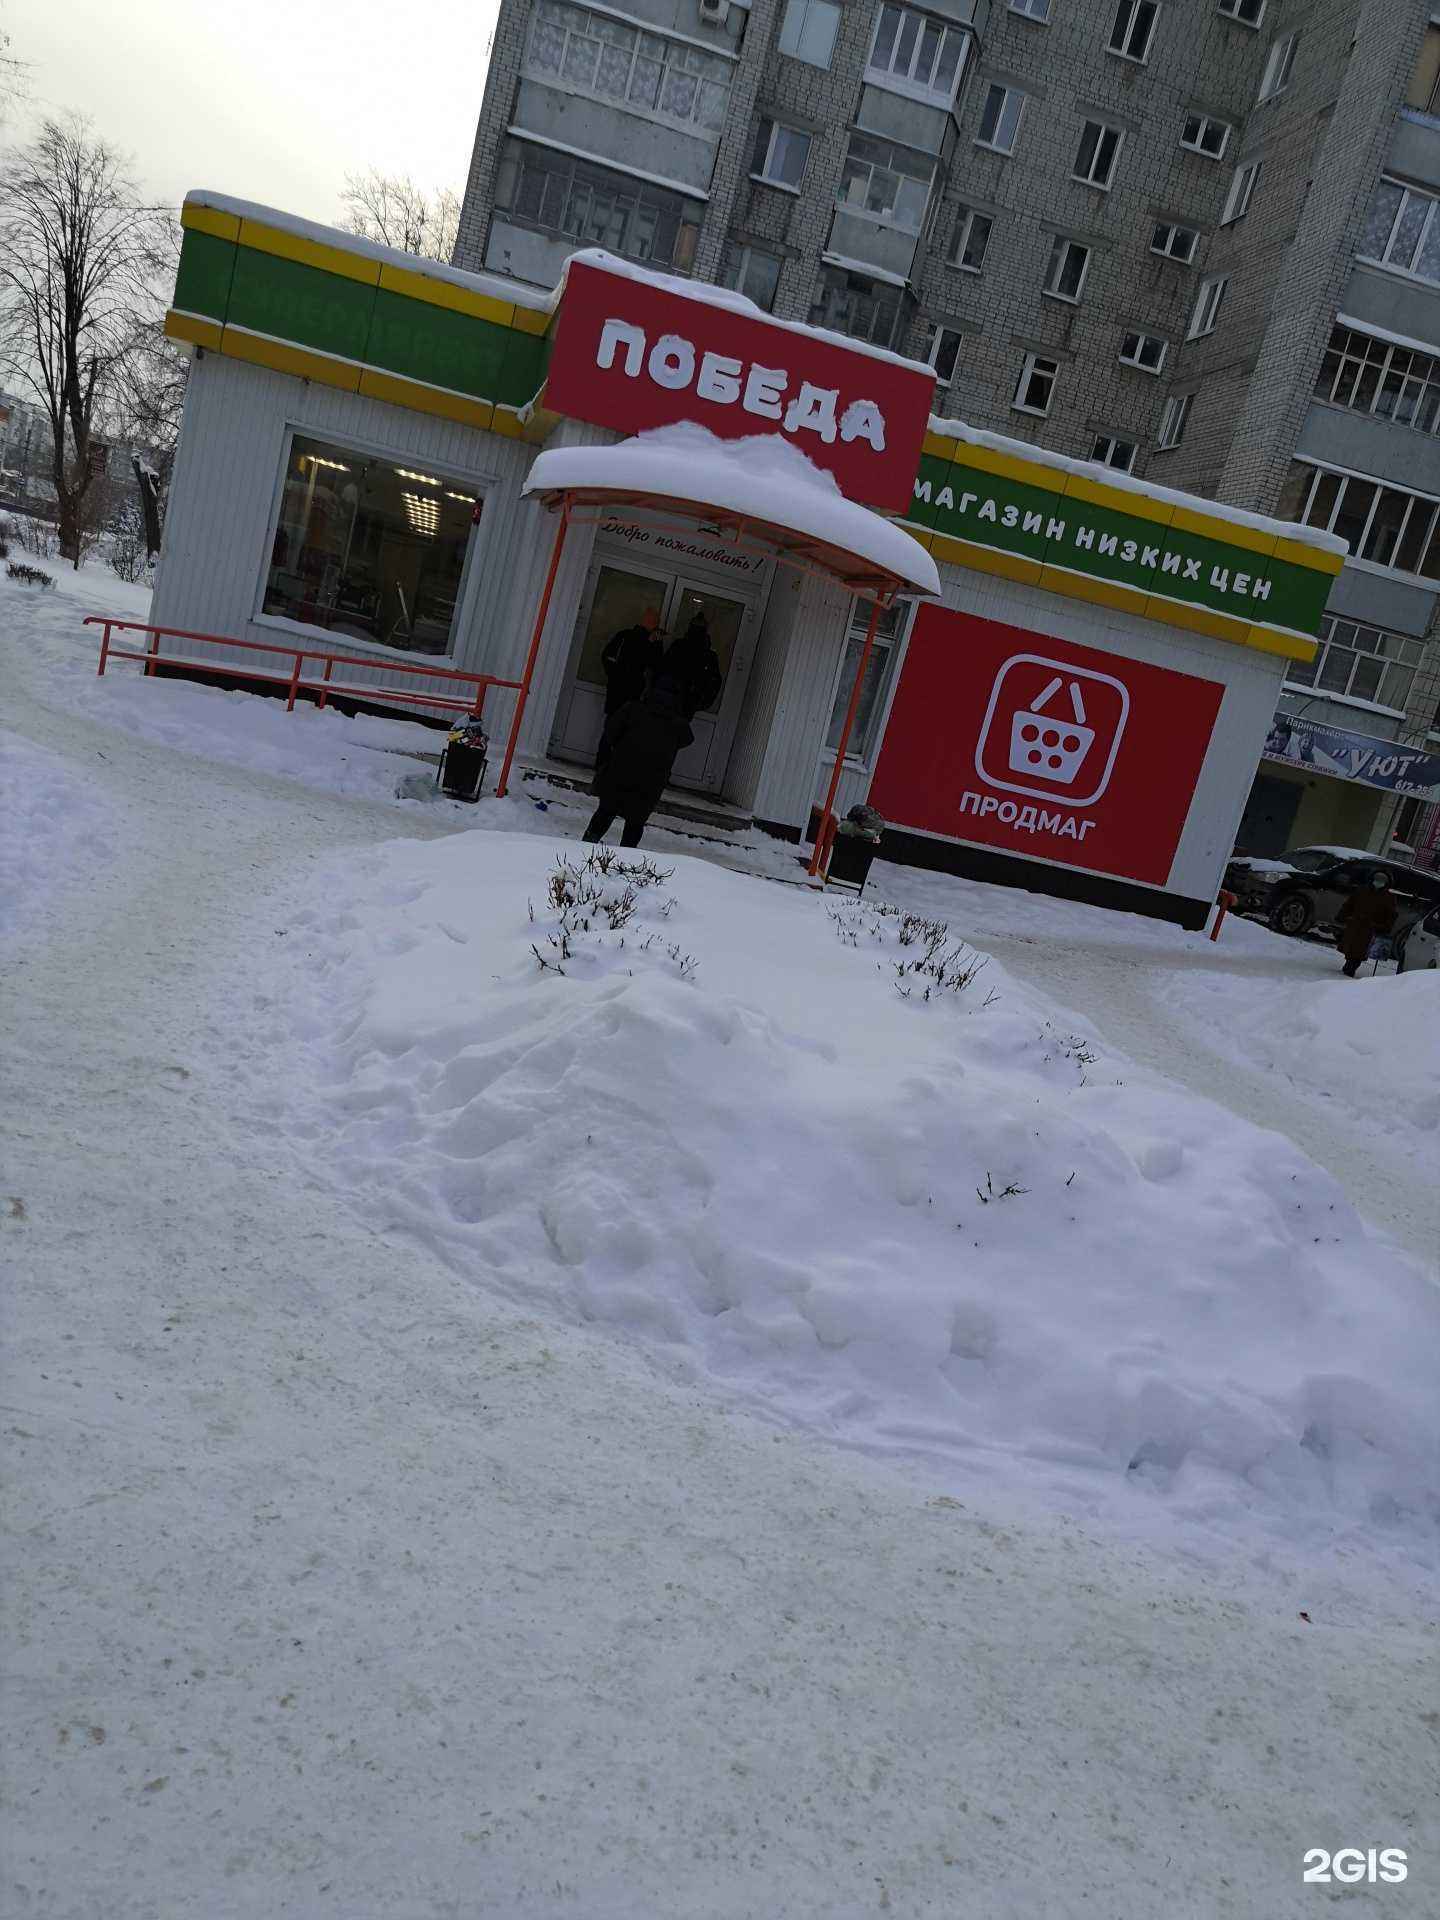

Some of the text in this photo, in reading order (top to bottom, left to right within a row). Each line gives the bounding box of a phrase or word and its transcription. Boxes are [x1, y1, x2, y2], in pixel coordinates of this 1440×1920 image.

[596, 318, 886, 452] ПОБЕДА
[602, 517, 650, 543] Добро
[913, 478, 1272, 600] МАГАЗИН НИЗКИХ ЦЕН
[959, 791, 1096, 841] ПРОДМАГ
